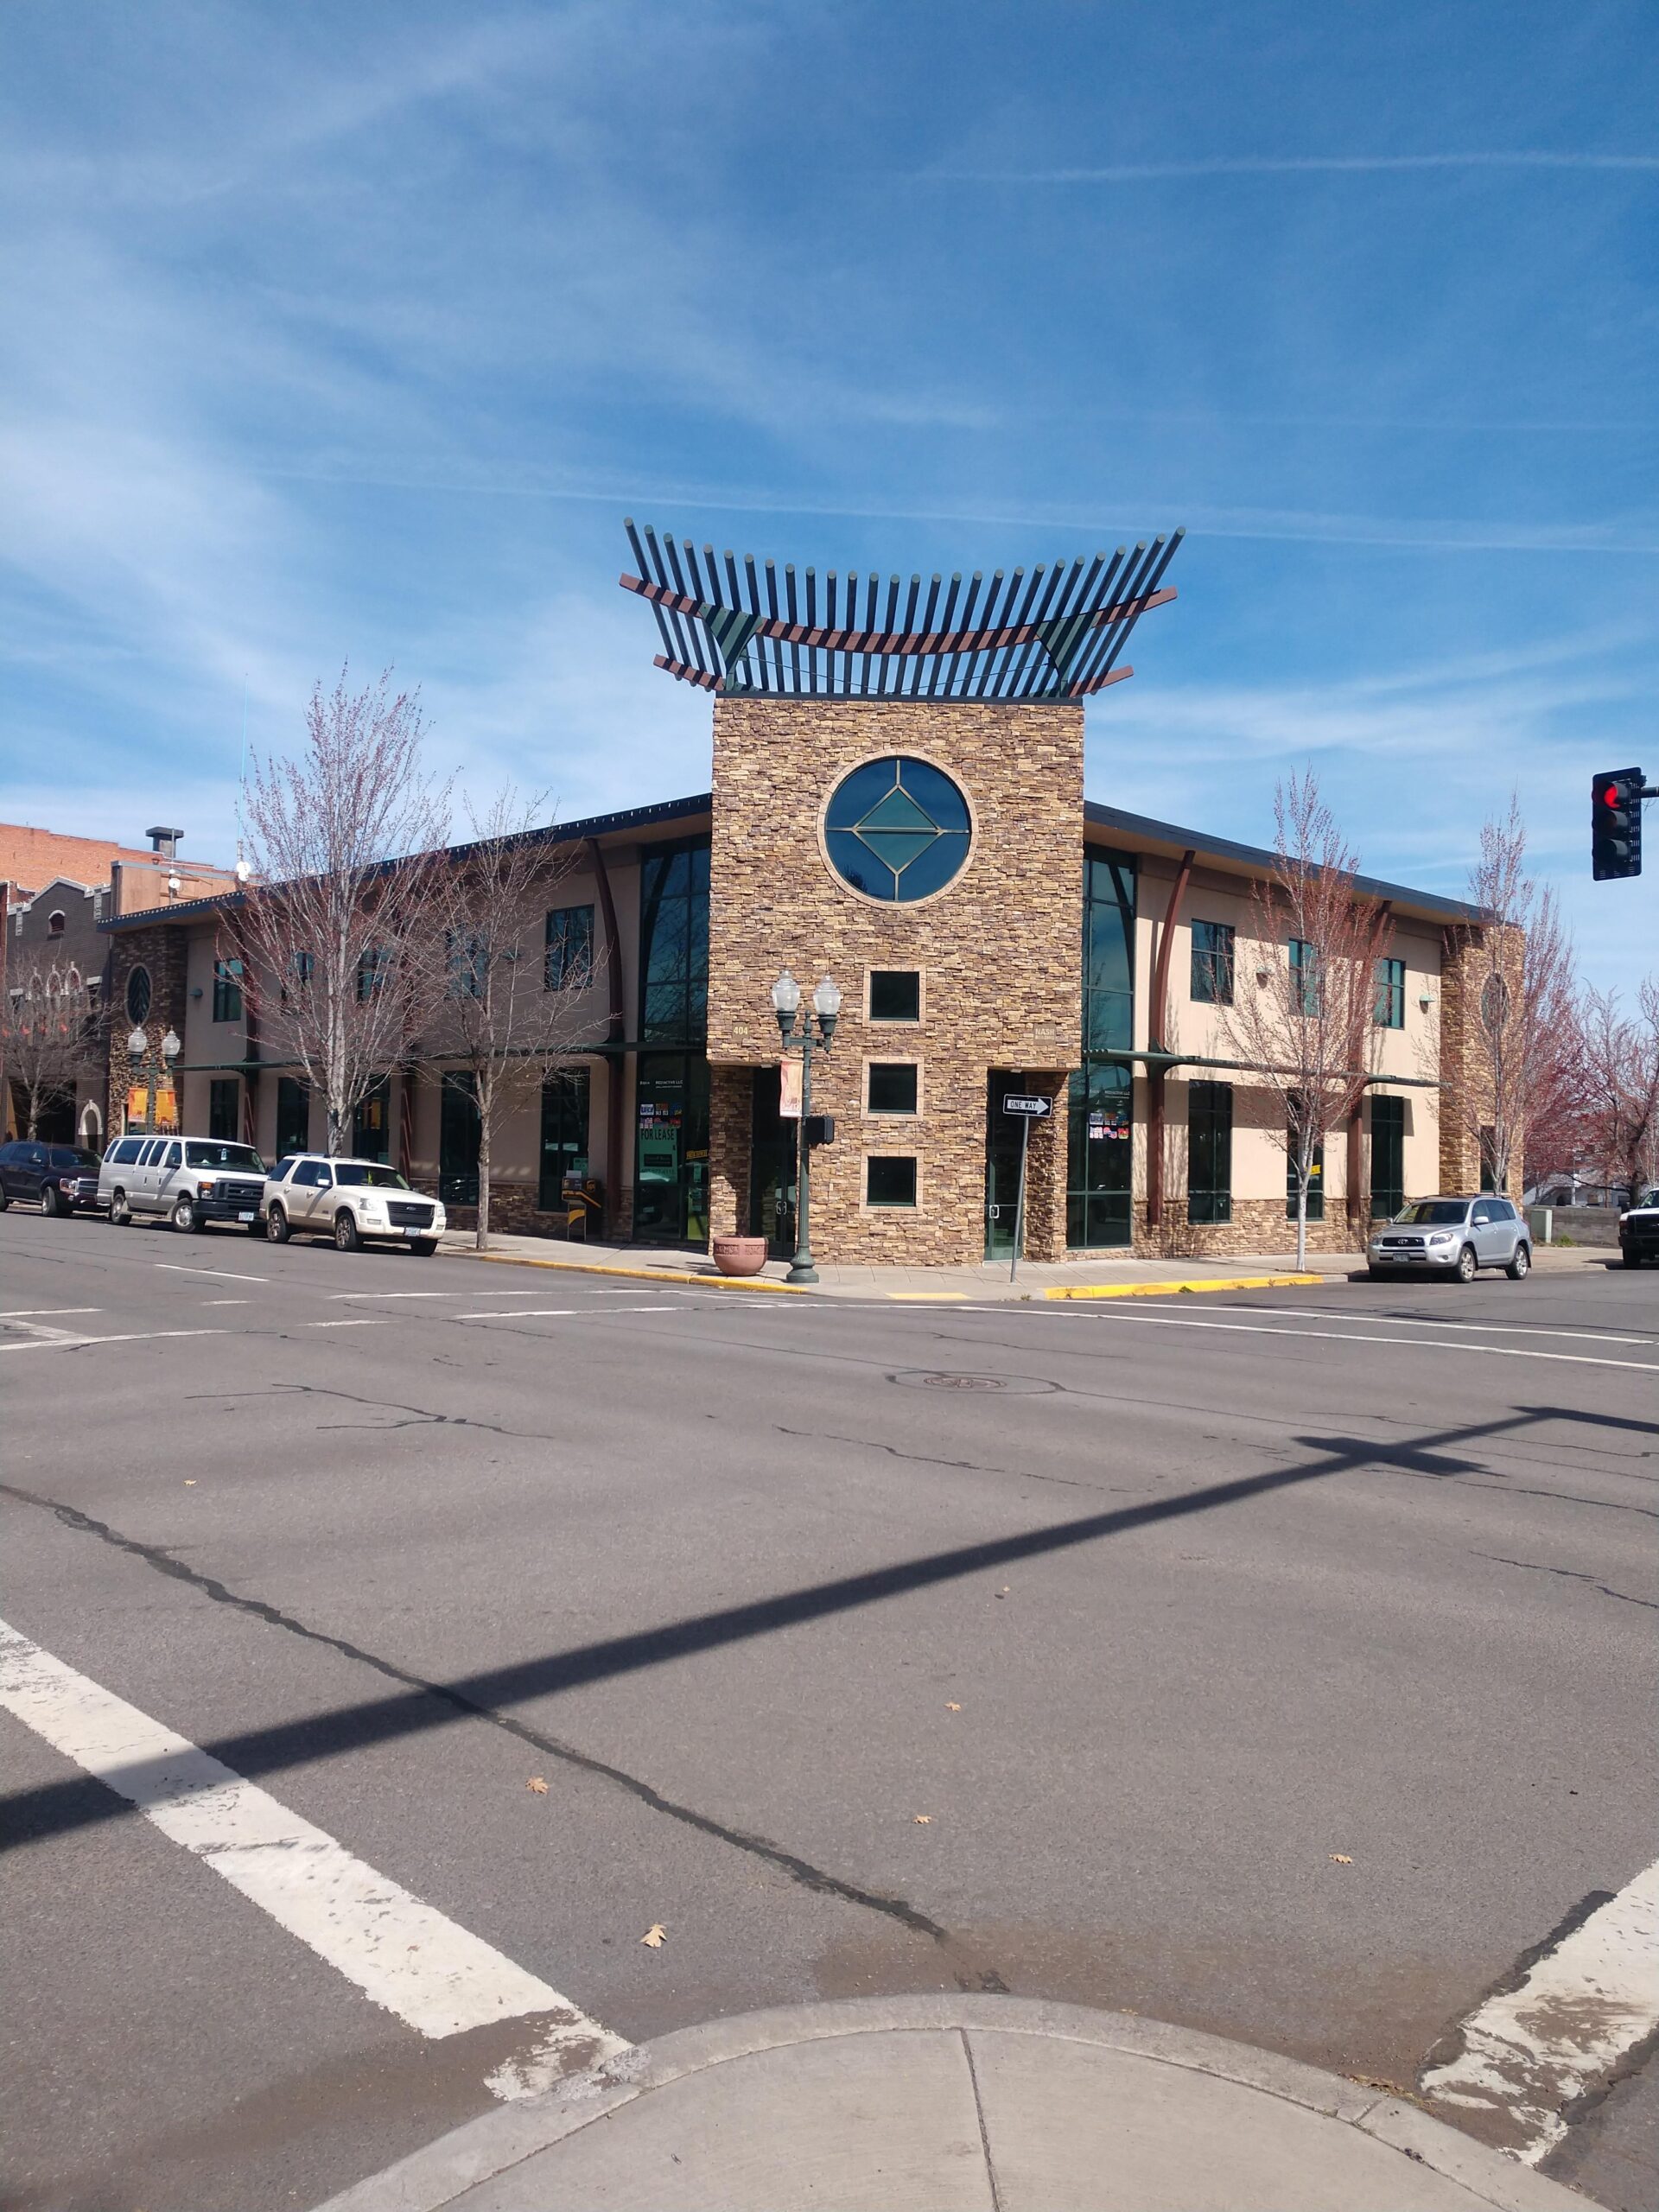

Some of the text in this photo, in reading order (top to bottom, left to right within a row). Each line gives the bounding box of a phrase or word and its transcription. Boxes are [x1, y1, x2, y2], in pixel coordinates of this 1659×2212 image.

[734, 1027, 748, 1035] 404
[640, 1128, 675, 1141] FOR LEASE
